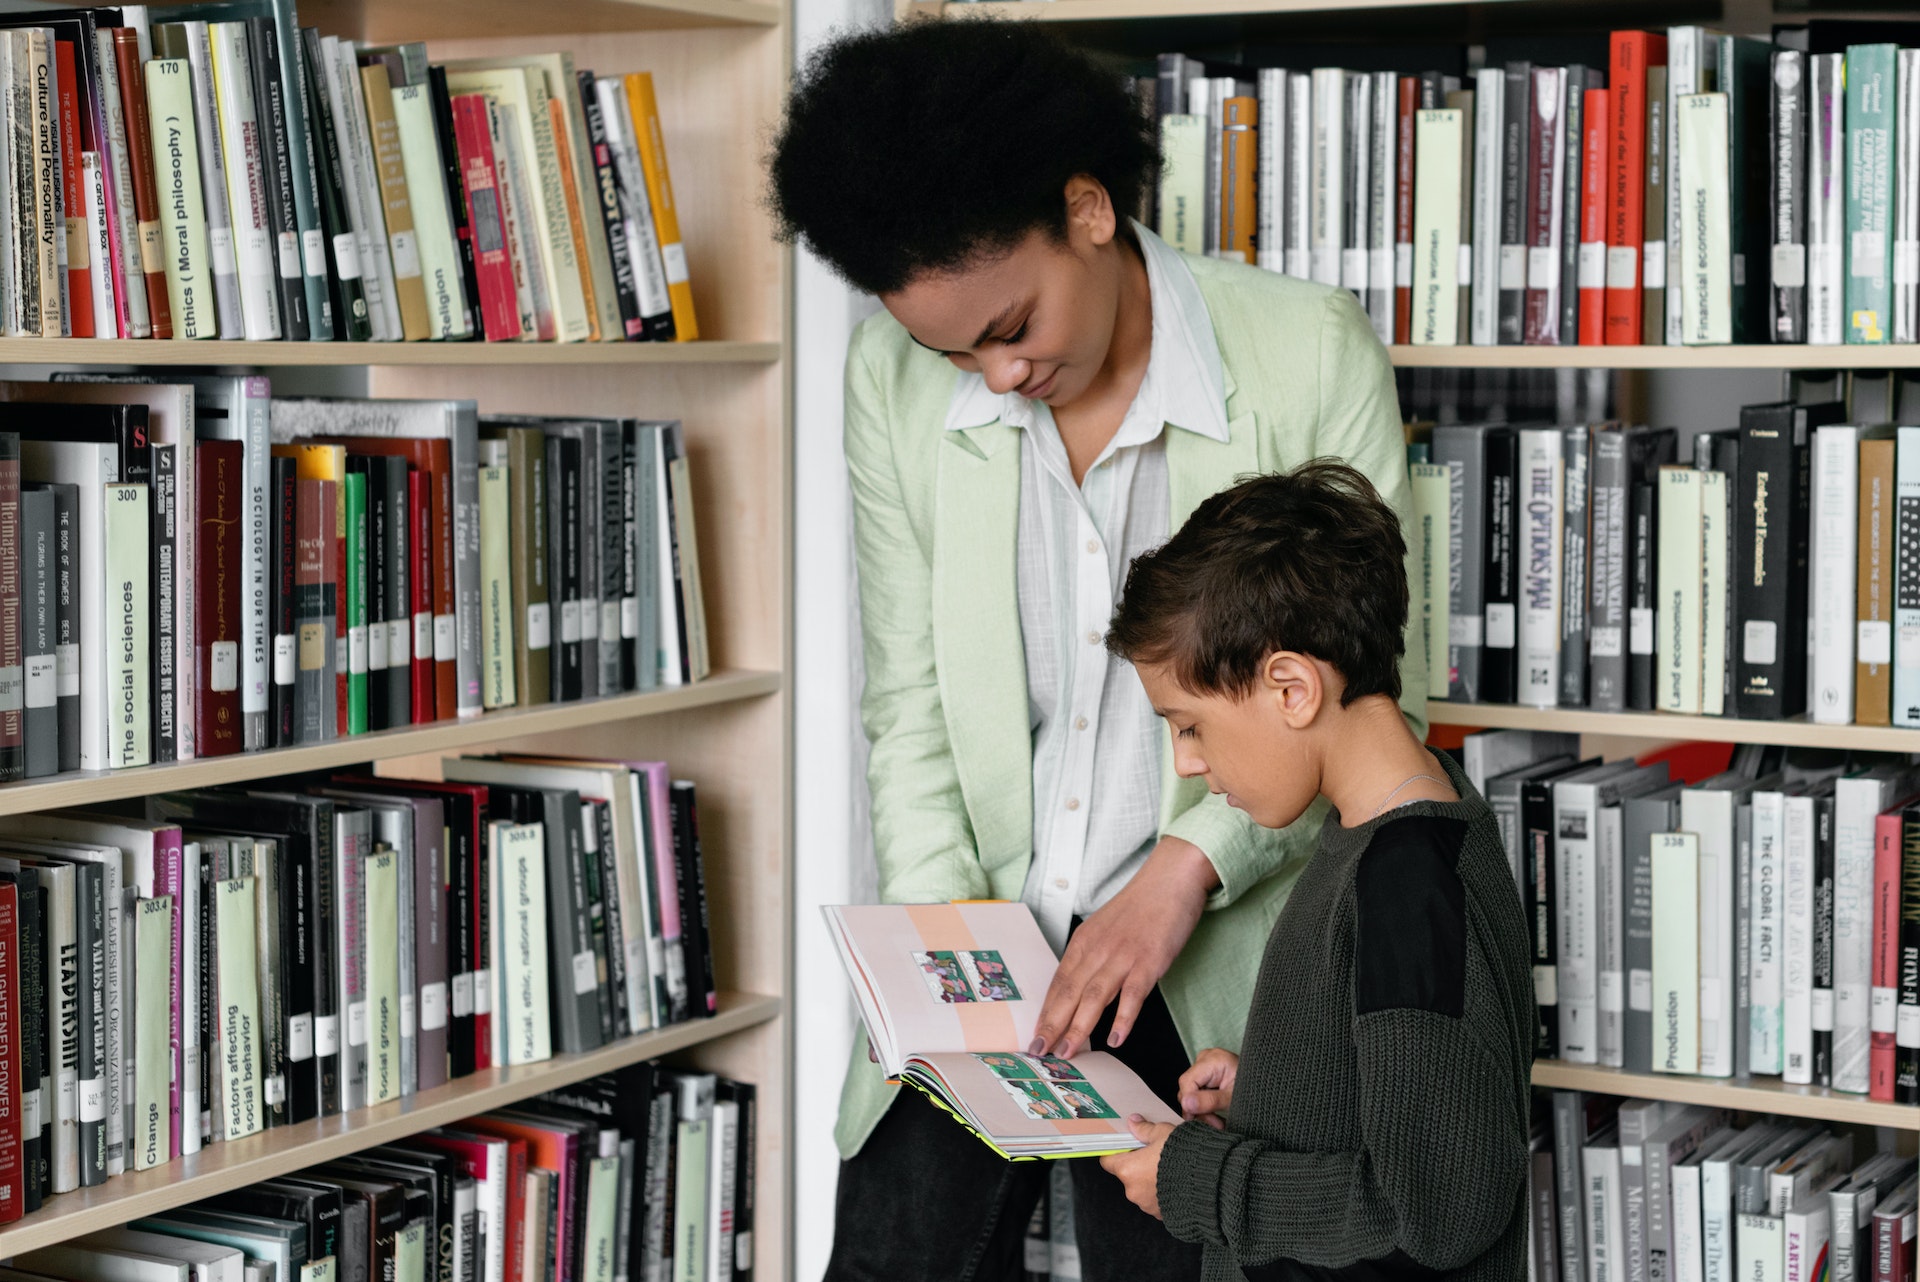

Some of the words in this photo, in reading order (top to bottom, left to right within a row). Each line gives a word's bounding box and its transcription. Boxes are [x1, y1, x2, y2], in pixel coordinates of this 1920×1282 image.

[160, 62, 179, 74] 170
[37, 64, 51, 122] Culture
[269, 81, 281, 126] ETHICS
[1617, 83, 1628, 127] Theories
[1690, 97, 1711, 109] 332
[1778, 94, 1797, 136] MONEY
[39, 124, 52, 154] and
[50, 119, 59, 154] VISUAL
[64, 110, 74, 167] MEASUREMENT
[69, 170, 75, 180] OF
[112, 107, 128, 147] Stop
[242, 121, 253, 160] PUBLIC
[272, 128, 282, 153] FOR
[1617, 131, 1628, 142] of
[1852, 128, 1861, 162] Second
[94, 170, 102, 180] C
[168, 128, 190, 221] philosophy
[1617, 145, 1628, 161] the
[1862, 128, 1873, 209] CORPORATE
[1874, 128, 1886, 202] FINANCIAL
[52, 156, 62, 212] ILLUSIONS
[96, 184, 105, 206] and
[118, 152, 132, 210] Killing
[275, 156, 288, 199] PUBLIC
[600, 167, 620, 221] NOT
[1617, 164, 1627, 208] LABOR
[1851, 165, 1861, 201] Edition
[40, 157, 54, 245] Personality
[98, 209, 106, 226] the
[281, 201, 294, 232] MANA
[99, 229, 108, 250] Box
[176, 225, 191, 272] Moral
[1696, 188, 1706, 271] economics
[46, 249, 54, 280] Wallace
[102, 257, 112, 290] Prince
[1431, 229, 1439, 279] women
[184, 287, 198, 338] Ethics
[434, 269, 453, 338] Religion
[1424, 284, 1440, 342] Working
[1696, 273, 1710, 341] Financial
[184, 394, 192, 431] PARMAN
[253, 409, 263, 468] KENDALL
[118, 489, 137, 501] 300
[284, 477, 294, 497] The
[1531, 466, 1553, 499] THE
[1754, 471, 1769, 527] Ecological
[61, 511, 69, 527] THE
[254, 487, 263, 563] SOCIOLOGY
[284, 500, 294, 520] One
[0, 502, 18, 593] Reimagining
[37, 531, 46, 568] PILGRIMS
[61, 530, 69, 551] BOOK
[284, 525, 293, 544] and
[284, 547, 293, 562] the
[458, 519, 468, 560] Focus
[1527, 501, 1553, 574] OPTIONS
[37, 570, 46, 579] IN
[61, 555, 69, 566] OF
[254, 571, 263, 582] IN
[1754, 528, 1766, 587] Economics
[38, 582, 46, 605] THEIR
[61, 570, 70, 606] ANSWERS
[159, 544, 173, 633] CONTEMPORARY
[254, 589, 264, 616] OUR
[281, 566, 293, 596] Many
[38, 607, 47, 625] OWN
[38, 628, 47, 648] LAND
[121, 580, 134, 663] sciences
[184, 577, 194, 658] ANTHROPOLOGY
[492, 579, 501, 657] interaction
[1672, 589, 1682, 670] economics
[160, 636, 173, 671] ISSUES
[255, 623, 264, 663] TIMES
[123, 669, 135, 724] social
[161, 674, 173, 688] IN
[493, 660, 503, 704] Social
[1671, 674, 1682, 708] Land
[161, 692, 173, 738] SOCIETY
[122, 730, 135, 766] The
[1761, 835, 1773, 861] THE
[227, 881, 244, 894] 304
[518, 857, 527, 906] groups
[1761, 866, 1773, 922] GLOBAL
[144, 900, 168, 914] 303.4
[1837, 895, 1855, 939] Plain
[22, 924, 31, 992] TWENTY-FIRST
[108, 907, 119, 985] LEADERSHIP
[200, 905, 208, 974] technology
[518, 910, 530, 966] national
[92, 940, 103, 987] VALUES
[60, 945, 79, 1070] LEADERSHIP
[94, 990, 104, 1013] and
[109, 989, 119, 1005] IN
[200, 986, 209, 1033] society
[23, 995, 32, 1067] CENTURY
[93, 1016, 105, 1064] PUBLIC
[227, 1006, 239, 1071] affecting
[376, 997, 388, 1048] groups
[524, 1013, 534, 1059] Racial,
[1665, 991, 1679, 1070] Production
[108, 1008, 122, 1116] ORGANIZATIONS
[241, 1014, 252, 1082] behavior
[0, 1051, 10, 1117] POWER
[379, 1053, 390, 1099] Social
[231, 1076, 240, 1136] Factors
[244, 1086, 255, 1131] social
[96, 1125, 107, 1171] Brookings
[146, 1103, 158, 1165] Change
[325, 1224, 335, 1256] The
[1708, 1218, 1722, 1244] The
[1837, 1208, 1852, 1234] Best
[312, 1263, 328, 1277] 307
[1837, 1244, 1852, 1269] The
[1879, 1222, 1891, 1274] BLACKFORD
